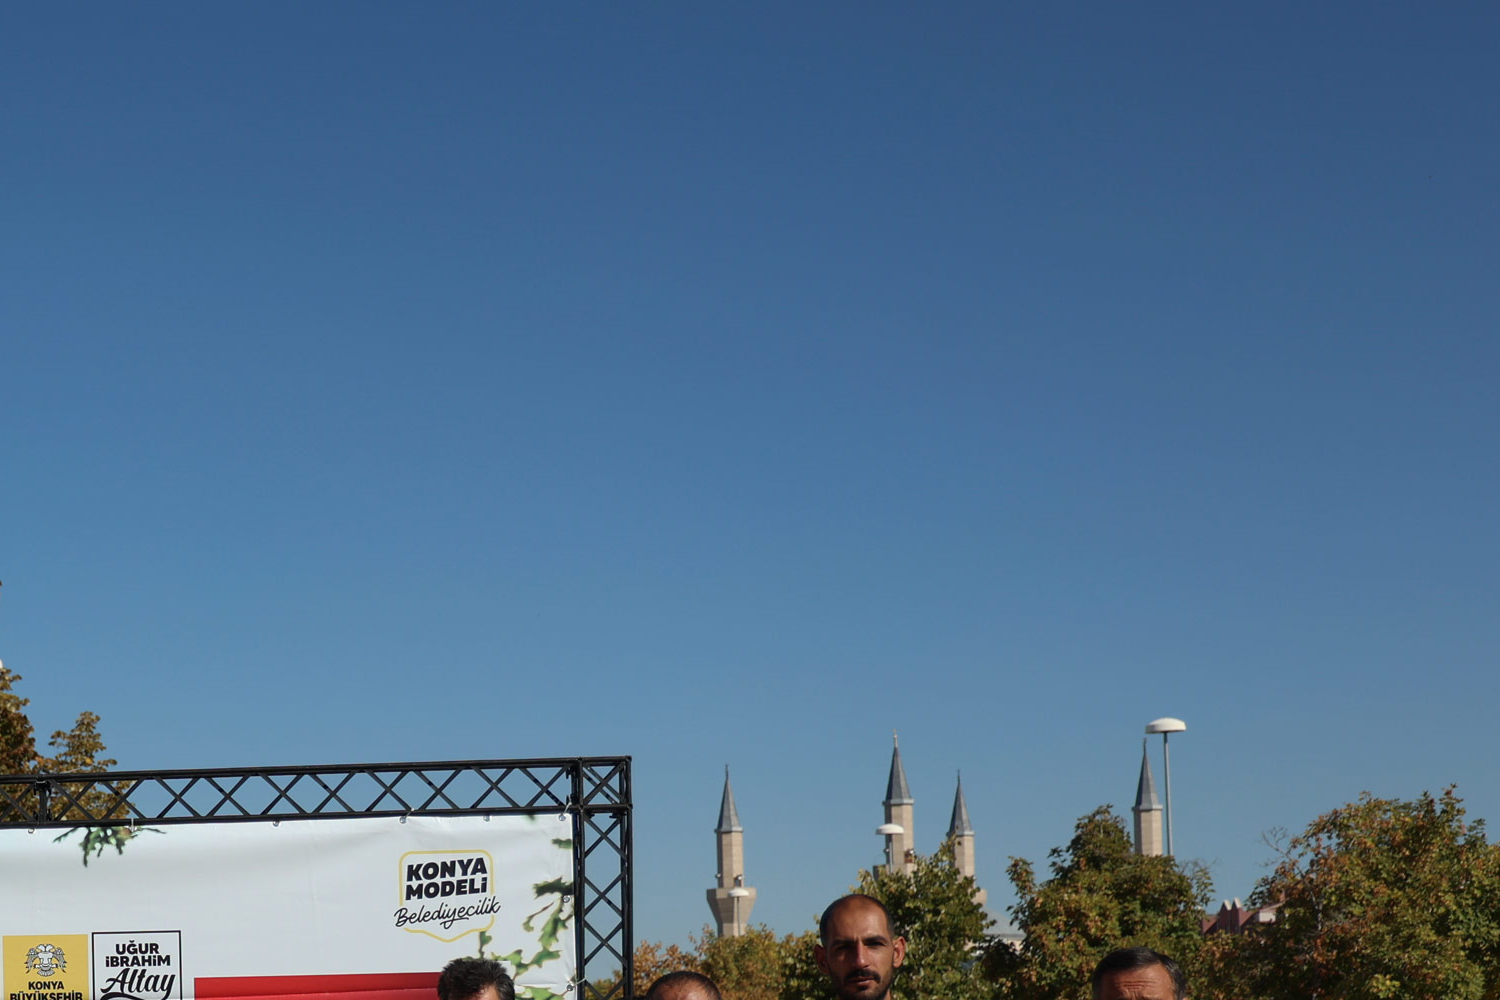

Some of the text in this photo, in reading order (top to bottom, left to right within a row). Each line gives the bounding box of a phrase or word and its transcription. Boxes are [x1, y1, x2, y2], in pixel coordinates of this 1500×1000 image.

[407, 858, 487, 882] KONYA
[394, 896, 500, 929] Belediyecilik
[116, 940, 159, 954] UĞUR
[28, 981, 64, 990] KONYA
